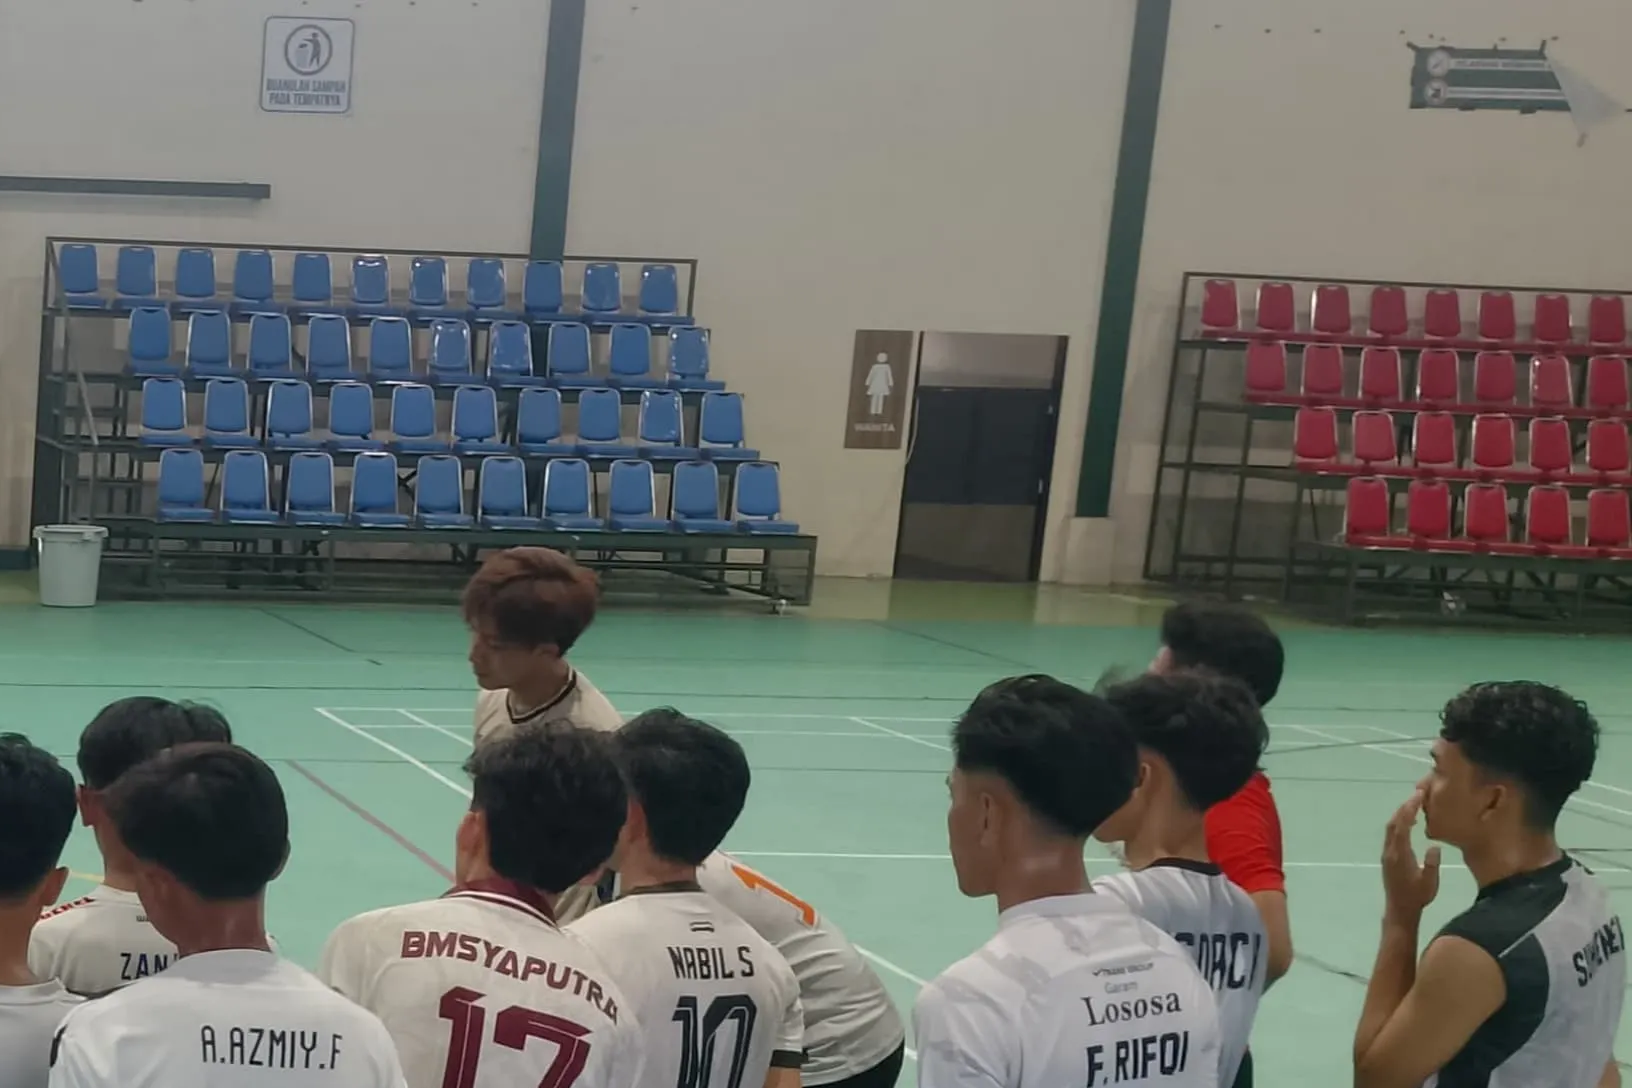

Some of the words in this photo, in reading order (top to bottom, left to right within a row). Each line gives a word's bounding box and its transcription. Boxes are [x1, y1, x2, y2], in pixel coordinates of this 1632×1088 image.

[401, 930, 619, 1026] BMSYAPUTRA
[667, 946, 734, 980] NABIL
[737, 946, 755, 977] S
[1080, 992, 1183, 1026] Lososa
[201, 1025, 344, 1070] A.AZMIY.F
